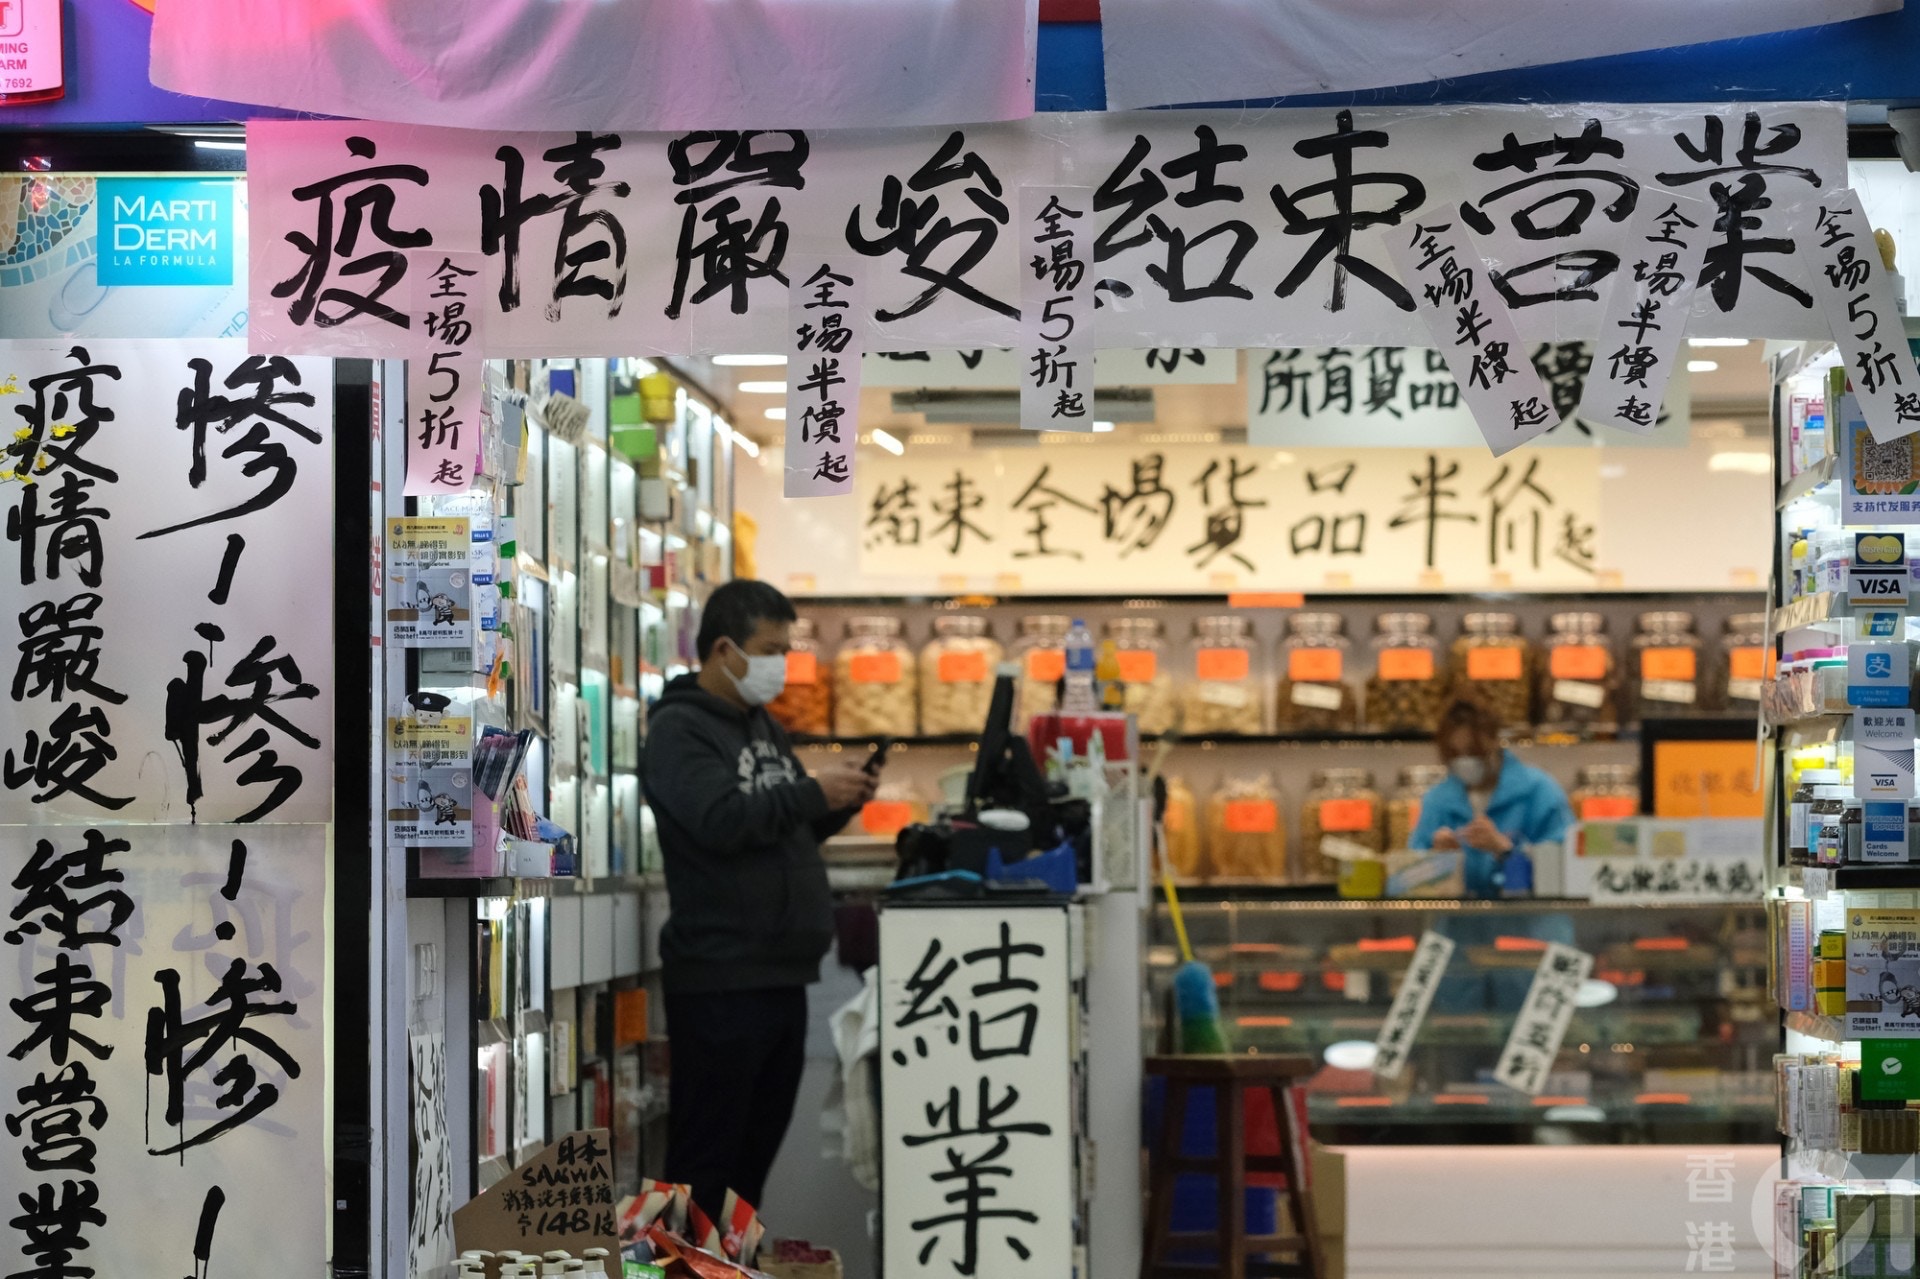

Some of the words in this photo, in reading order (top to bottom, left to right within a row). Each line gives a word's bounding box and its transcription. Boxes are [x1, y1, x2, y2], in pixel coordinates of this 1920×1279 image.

[5, 78, 32, 88] 7692
[114, 196, 216, 221] MARTI
[114, 224, 216, 250] DERM
[114, 256, 132, 265] LA
[140, 256, 216, 265] FORMULA
[1856, 579, 1901, 594] VISA
[1863, 716, 1905, 727] 歡迎光臨
[1865, 730, 1903, 738] Welcome
[1874, 778, 1895, 787] VISA
[892, 920, 1052, 1276] 結業
[557, 1134, 608, 1165] 日本
